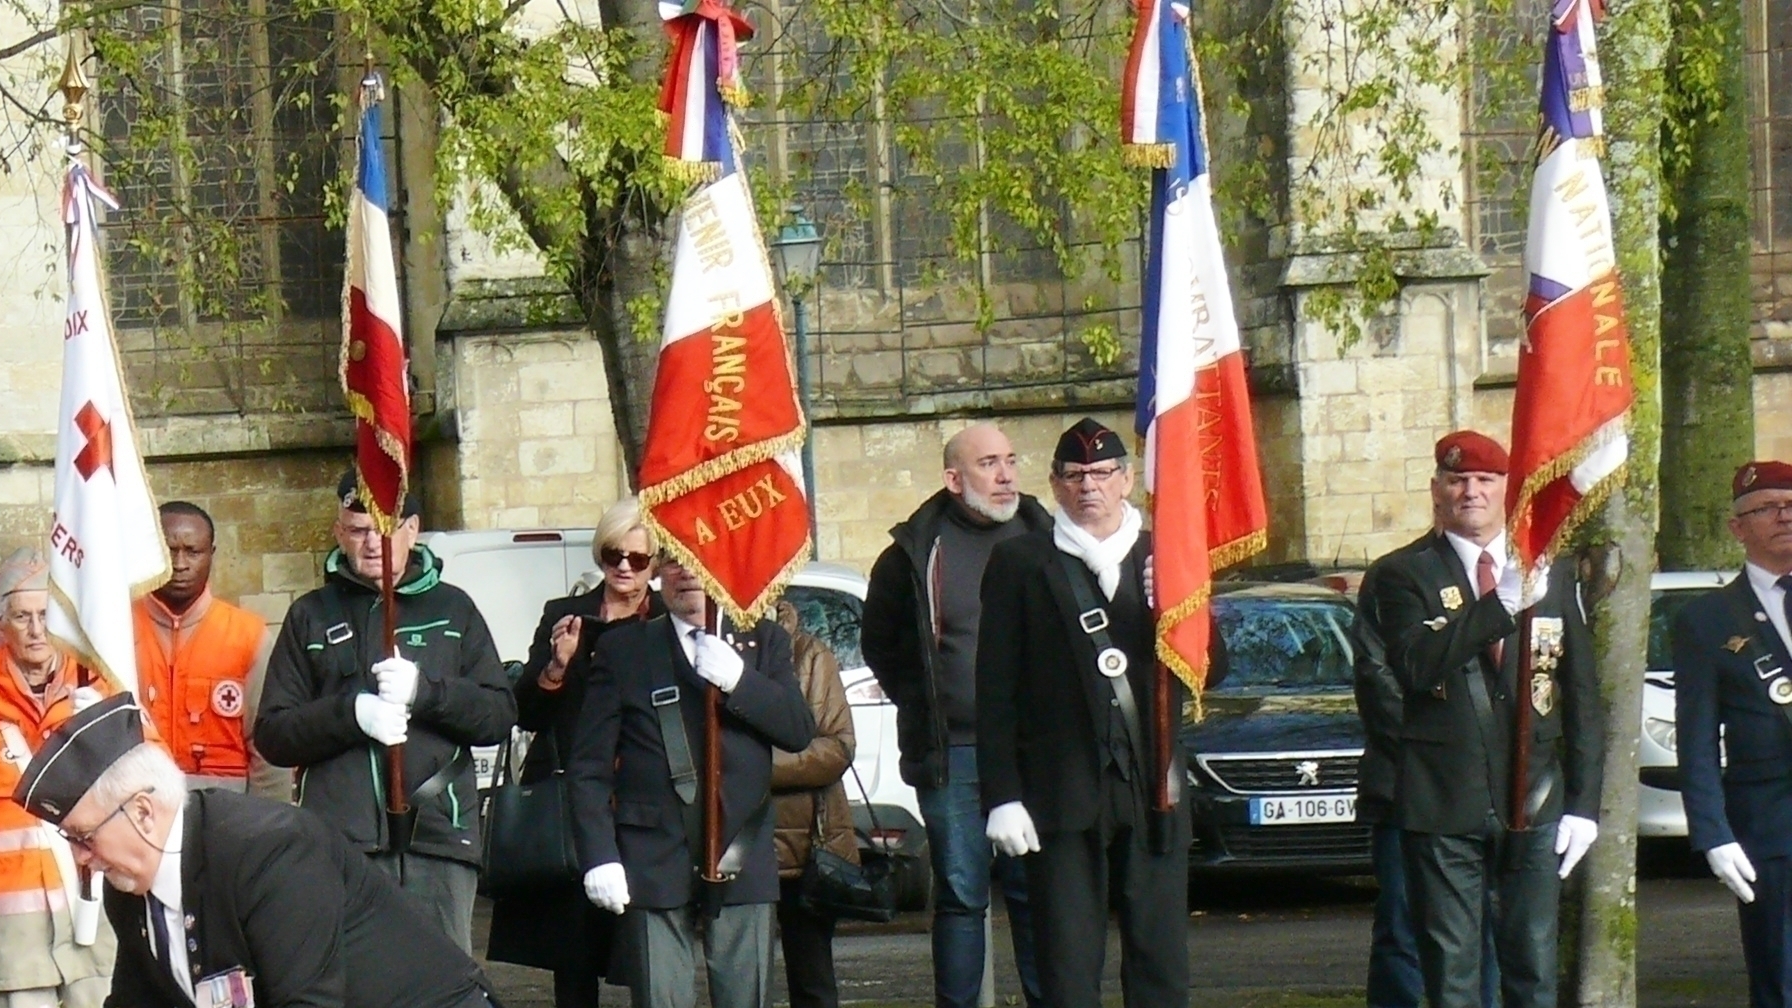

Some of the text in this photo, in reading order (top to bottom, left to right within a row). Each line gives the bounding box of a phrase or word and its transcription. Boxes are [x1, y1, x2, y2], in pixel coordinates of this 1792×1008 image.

[1554, 170, 1623, 388] NATIONALE
[704, 290, 748, 443] FRANÇAIS
[50, 511, 85, 570] ERS
[695, 473, 787, 546] A EUX
